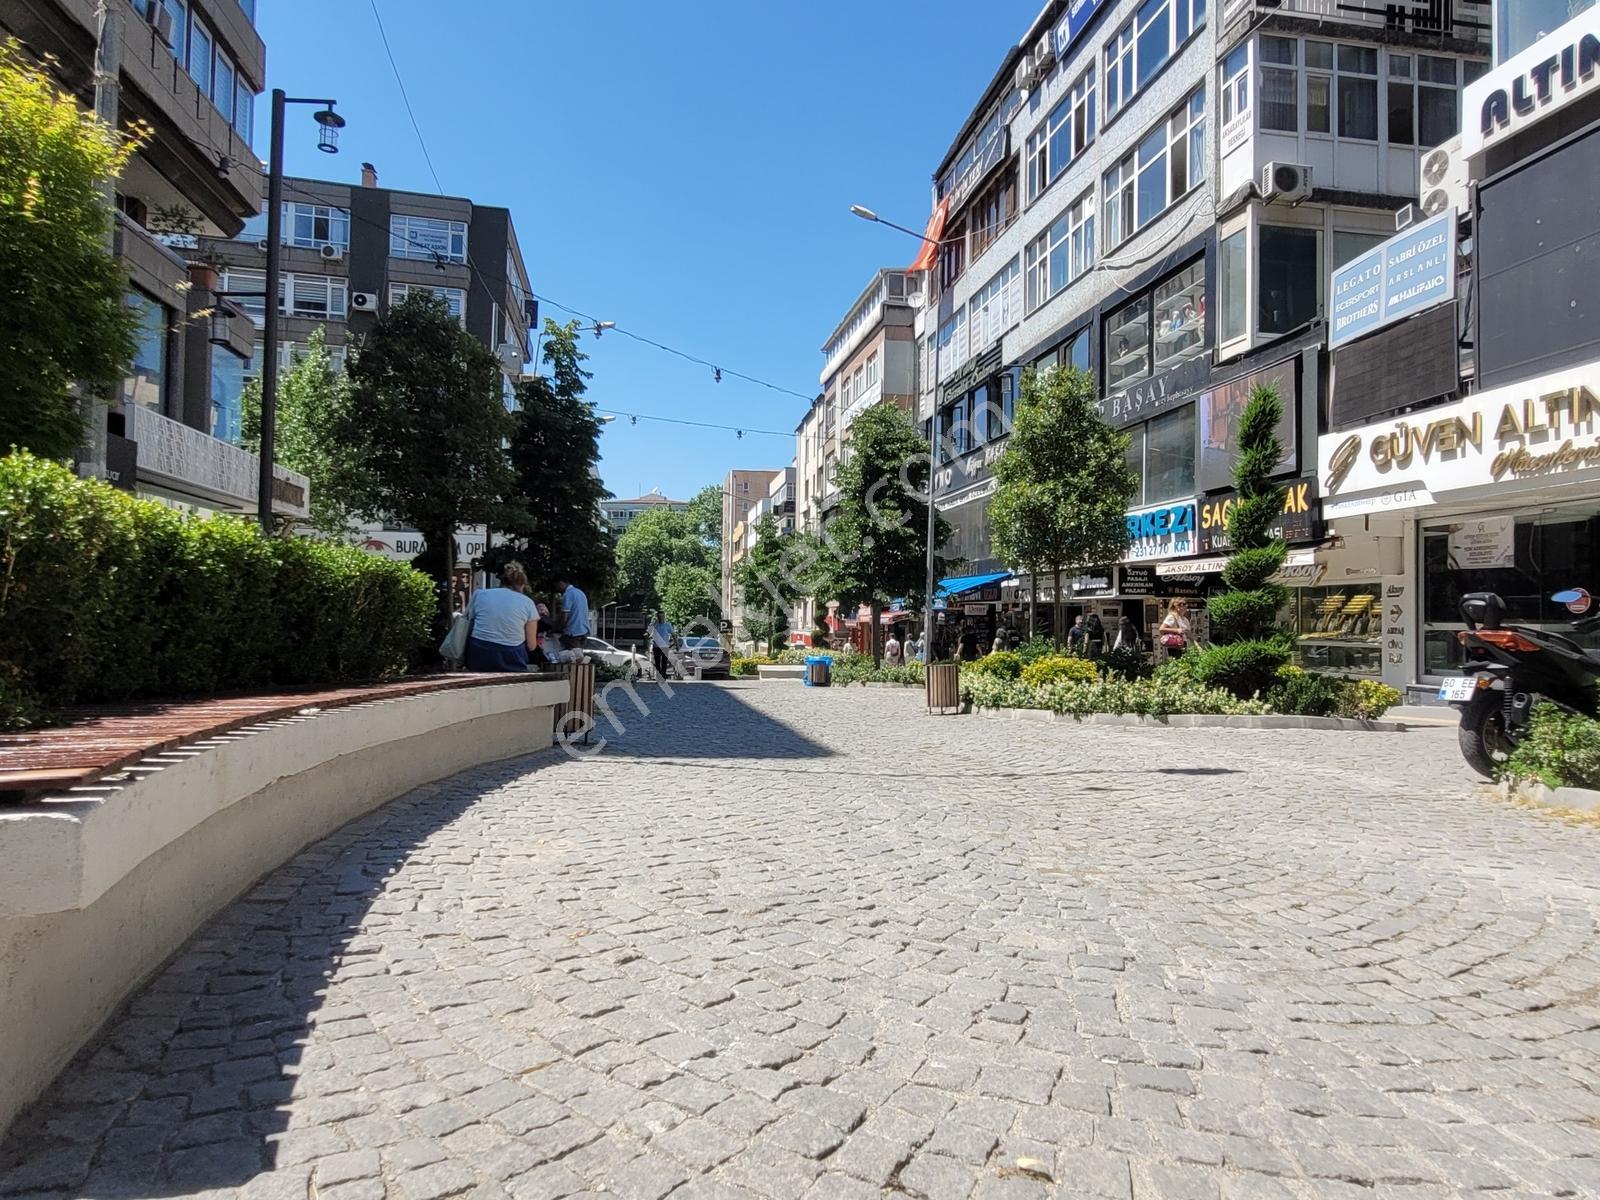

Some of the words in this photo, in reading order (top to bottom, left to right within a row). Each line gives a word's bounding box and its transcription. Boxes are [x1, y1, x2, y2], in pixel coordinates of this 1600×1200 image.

[1418, 234, 1447, 253] ÖZEL
[1337, 264, 1381, 295] LEGATO
[1336, 300, 1379, 331] BROTHERS
[1370, 411, 1482, 466] GÜVEN
[1394, 489, 1417, 502] GIA
[1127, 504, 1195, 540] RKEZİ
[396, 540, 427, 554] BURA
[1173, 540, 1190, 553] KAT
[1165, 563, 1193, 573] AKSOY
[1443, 678, 1456, 688] 60
[1450, 689, 1466, 699] 165
